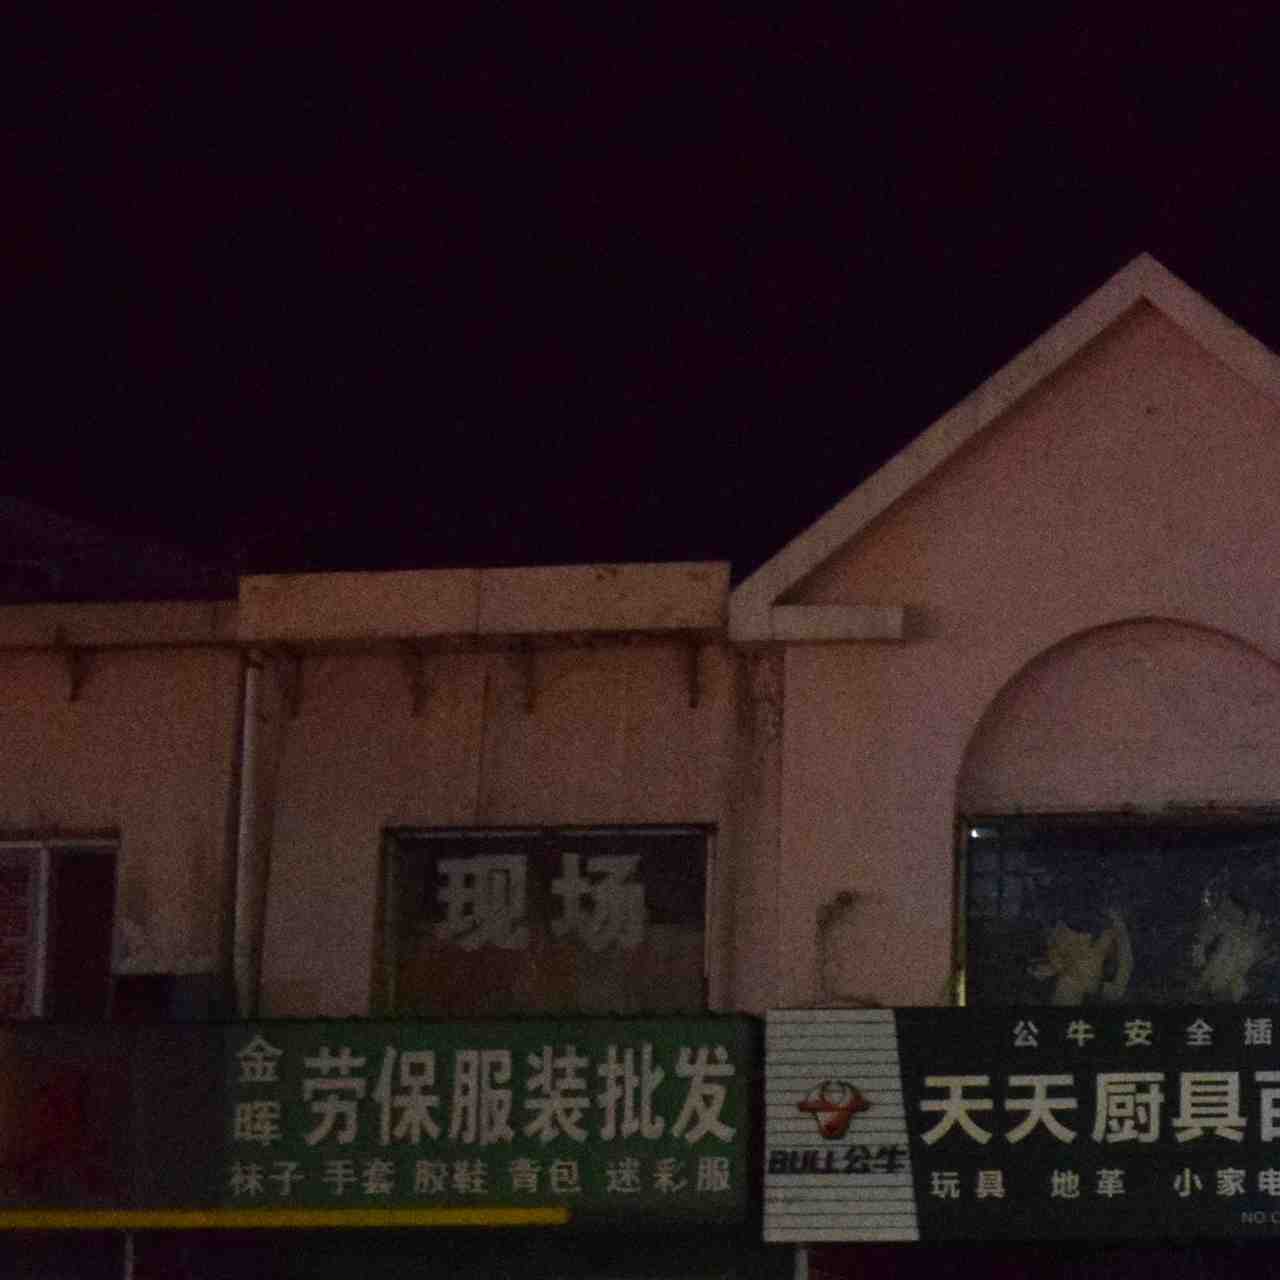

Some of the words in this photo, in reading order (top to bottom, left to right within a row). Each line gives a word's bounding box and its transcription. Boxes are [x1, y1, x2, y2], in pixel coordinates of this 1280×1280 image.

[433, 852, 646, 951] 现场
[303, 1042, 737, 1146] 劳保服装批发
[322, 1160, 397, 1196] 手套
[606, 1156, 731, 1194] 迷彩服
[929, 1169, 1008, 1200] 玩具
[1051, 1168, 1127, 1199] 地革
